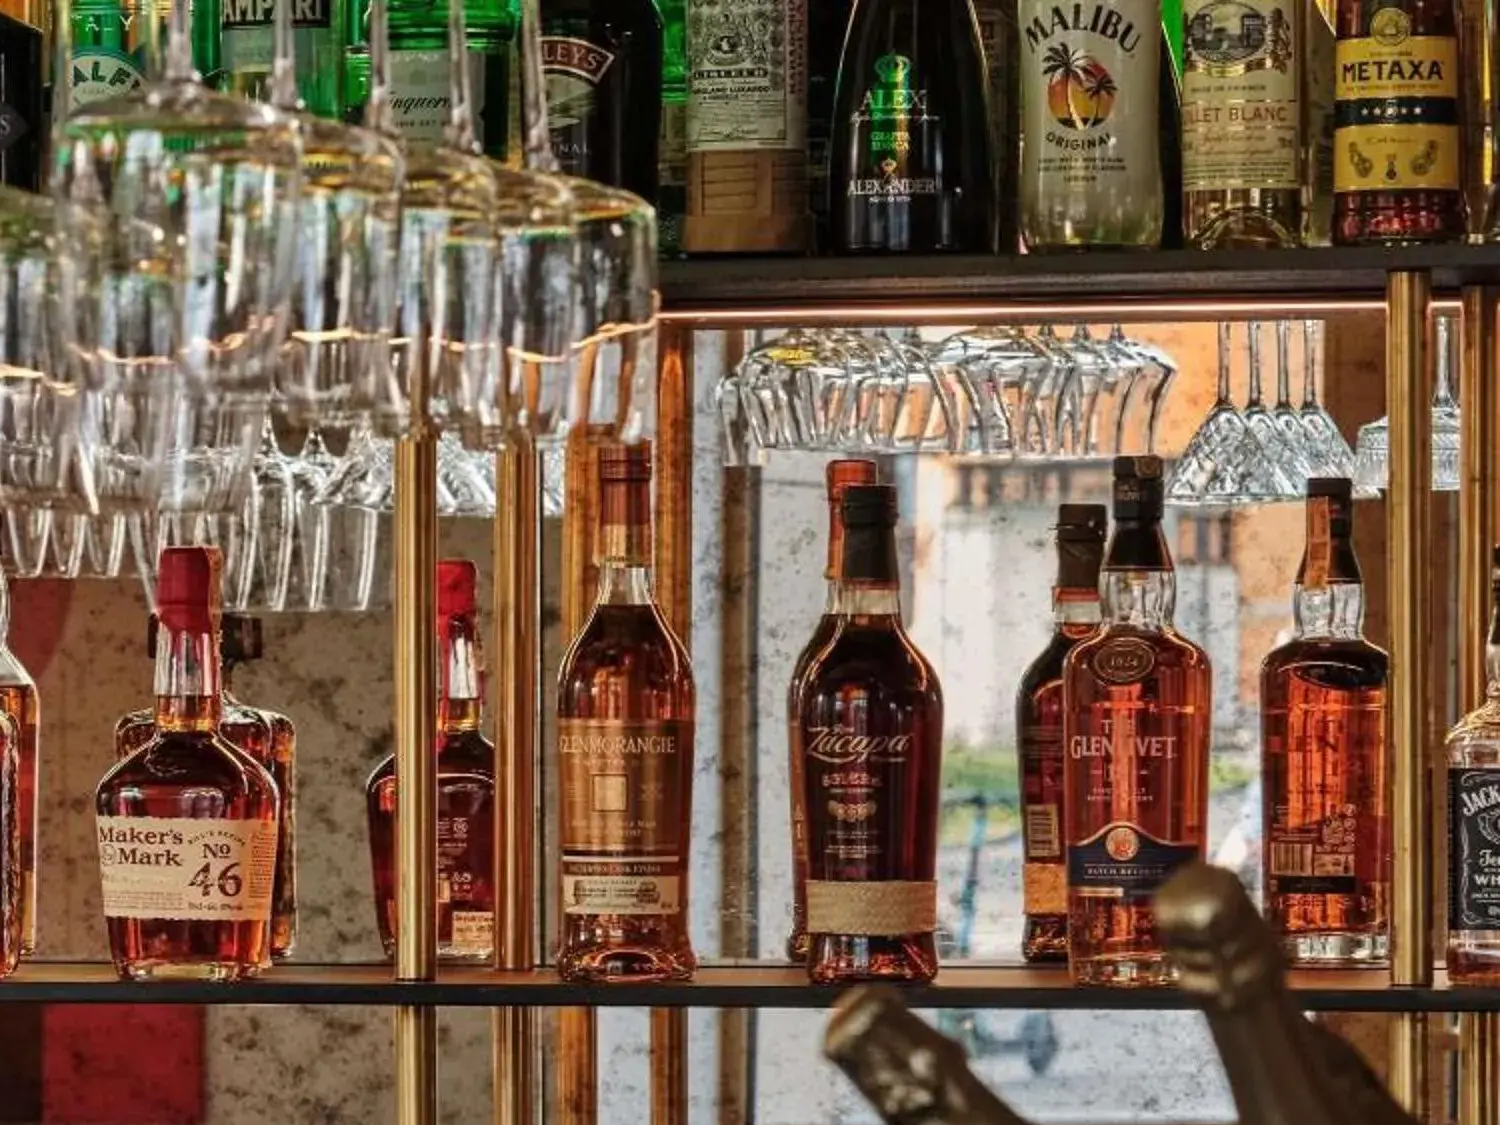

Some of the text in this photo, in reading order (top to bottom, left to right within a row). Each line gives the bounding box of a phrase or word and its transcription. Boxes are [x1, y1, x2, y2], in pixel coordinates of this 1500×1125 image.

[1025, 3, 1141, 54] MALIBU
[1342, 60, 1443, 83] METAXA
[1228, 105, 1288, 121] BLANC
[847, 178, 938, 197] ALEXANDER
[99, 826, 183, 845] Maker's
[118, 848, 182, 867] Mark
[187, 862, 243, 897] 46
